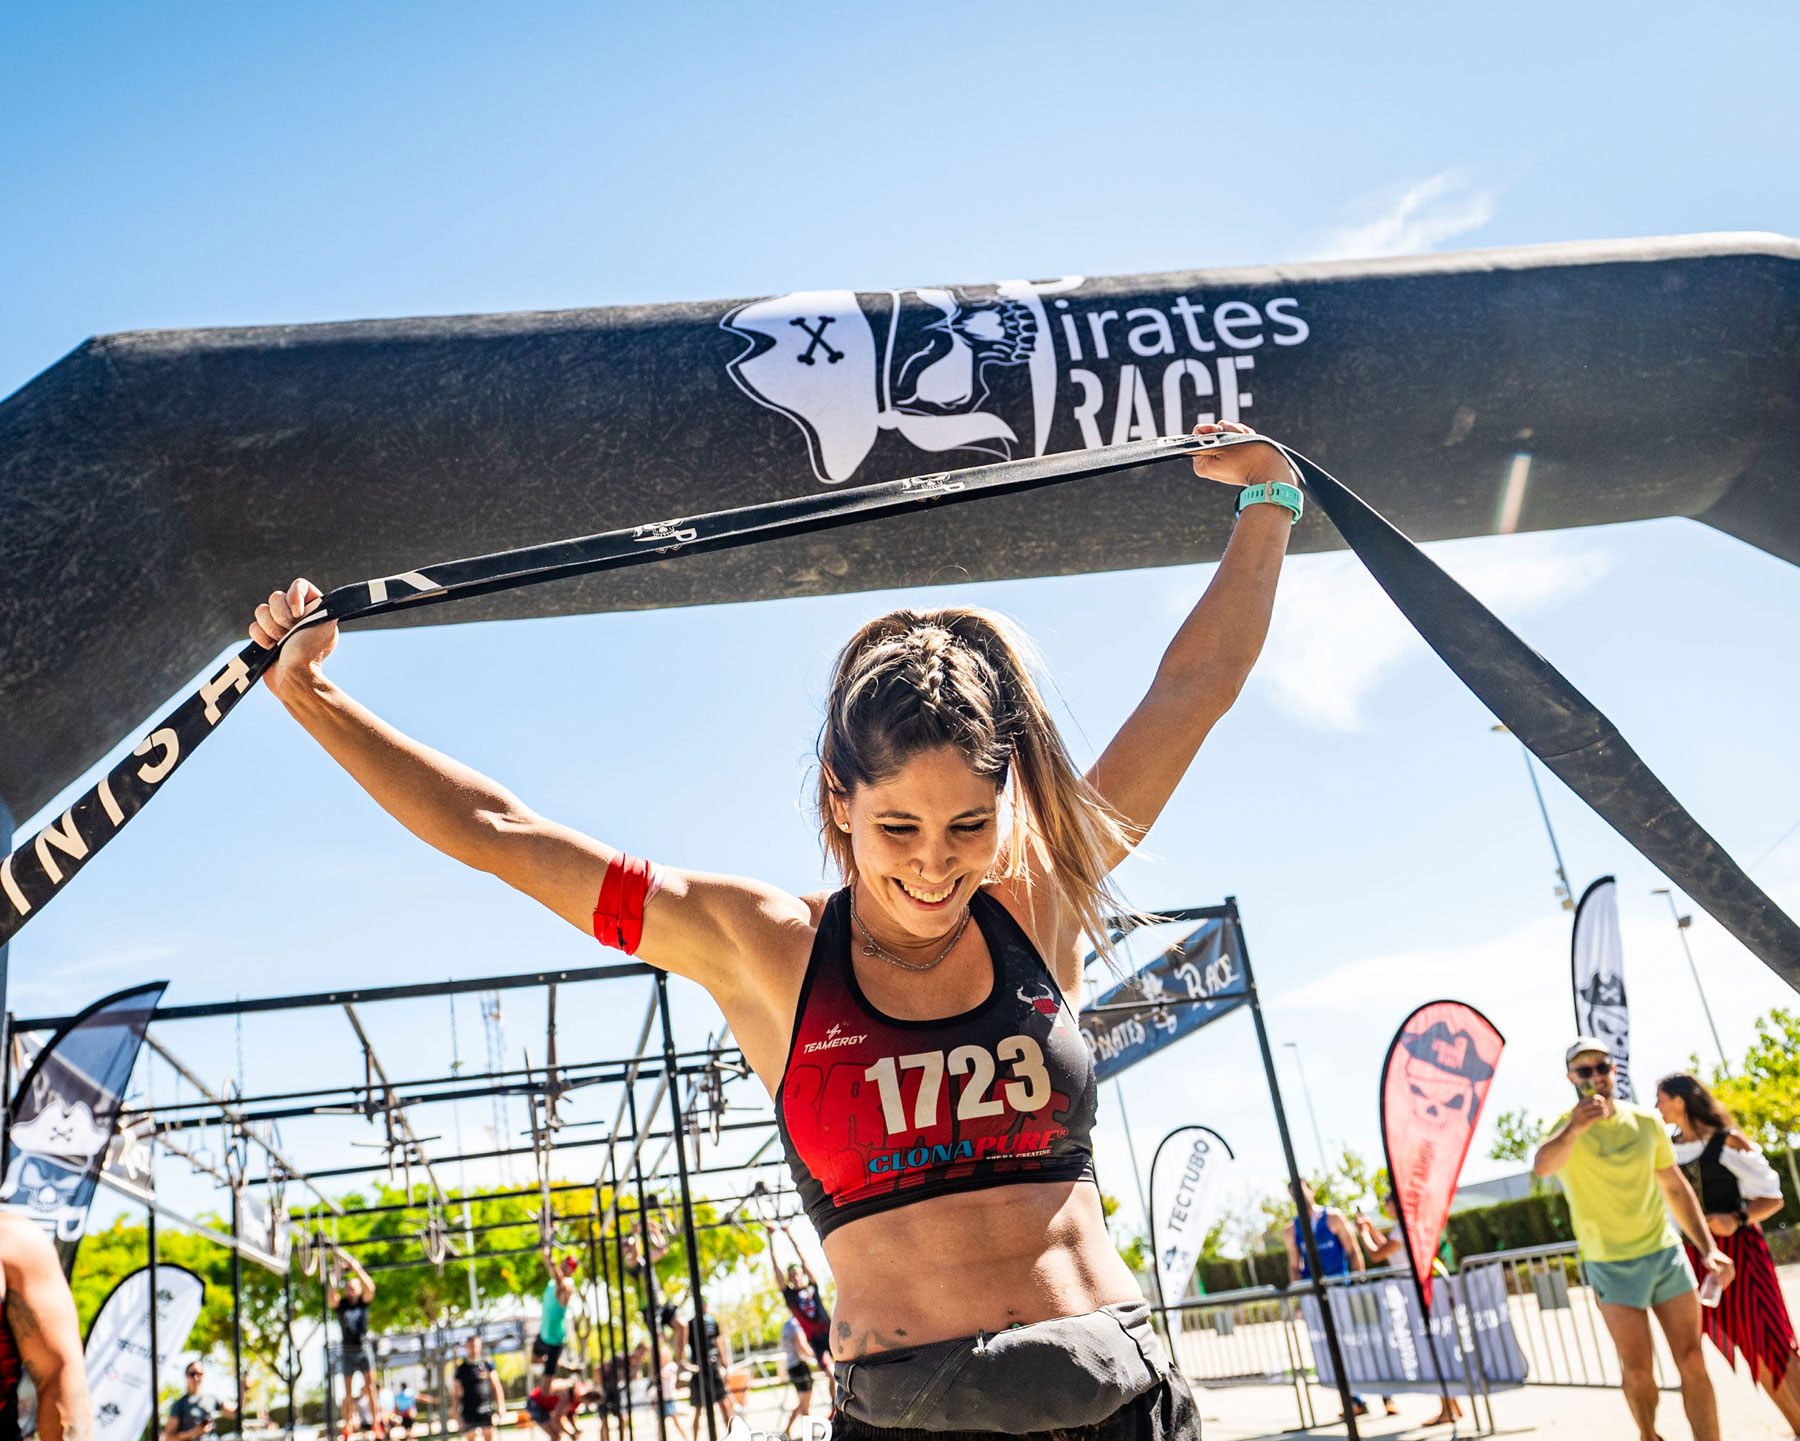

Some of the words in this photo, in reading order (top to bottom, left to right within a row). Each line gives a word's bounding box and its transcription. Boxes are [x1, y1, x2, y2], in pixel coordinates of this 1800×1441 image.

[1070, 355, 1255, 450] RACE
[803, 1034, 868, 1055] TEAMERGY
[864, 1035, 1051, 1134] 1723
[1168, 1139, 1210, 1233] TECTUBO
